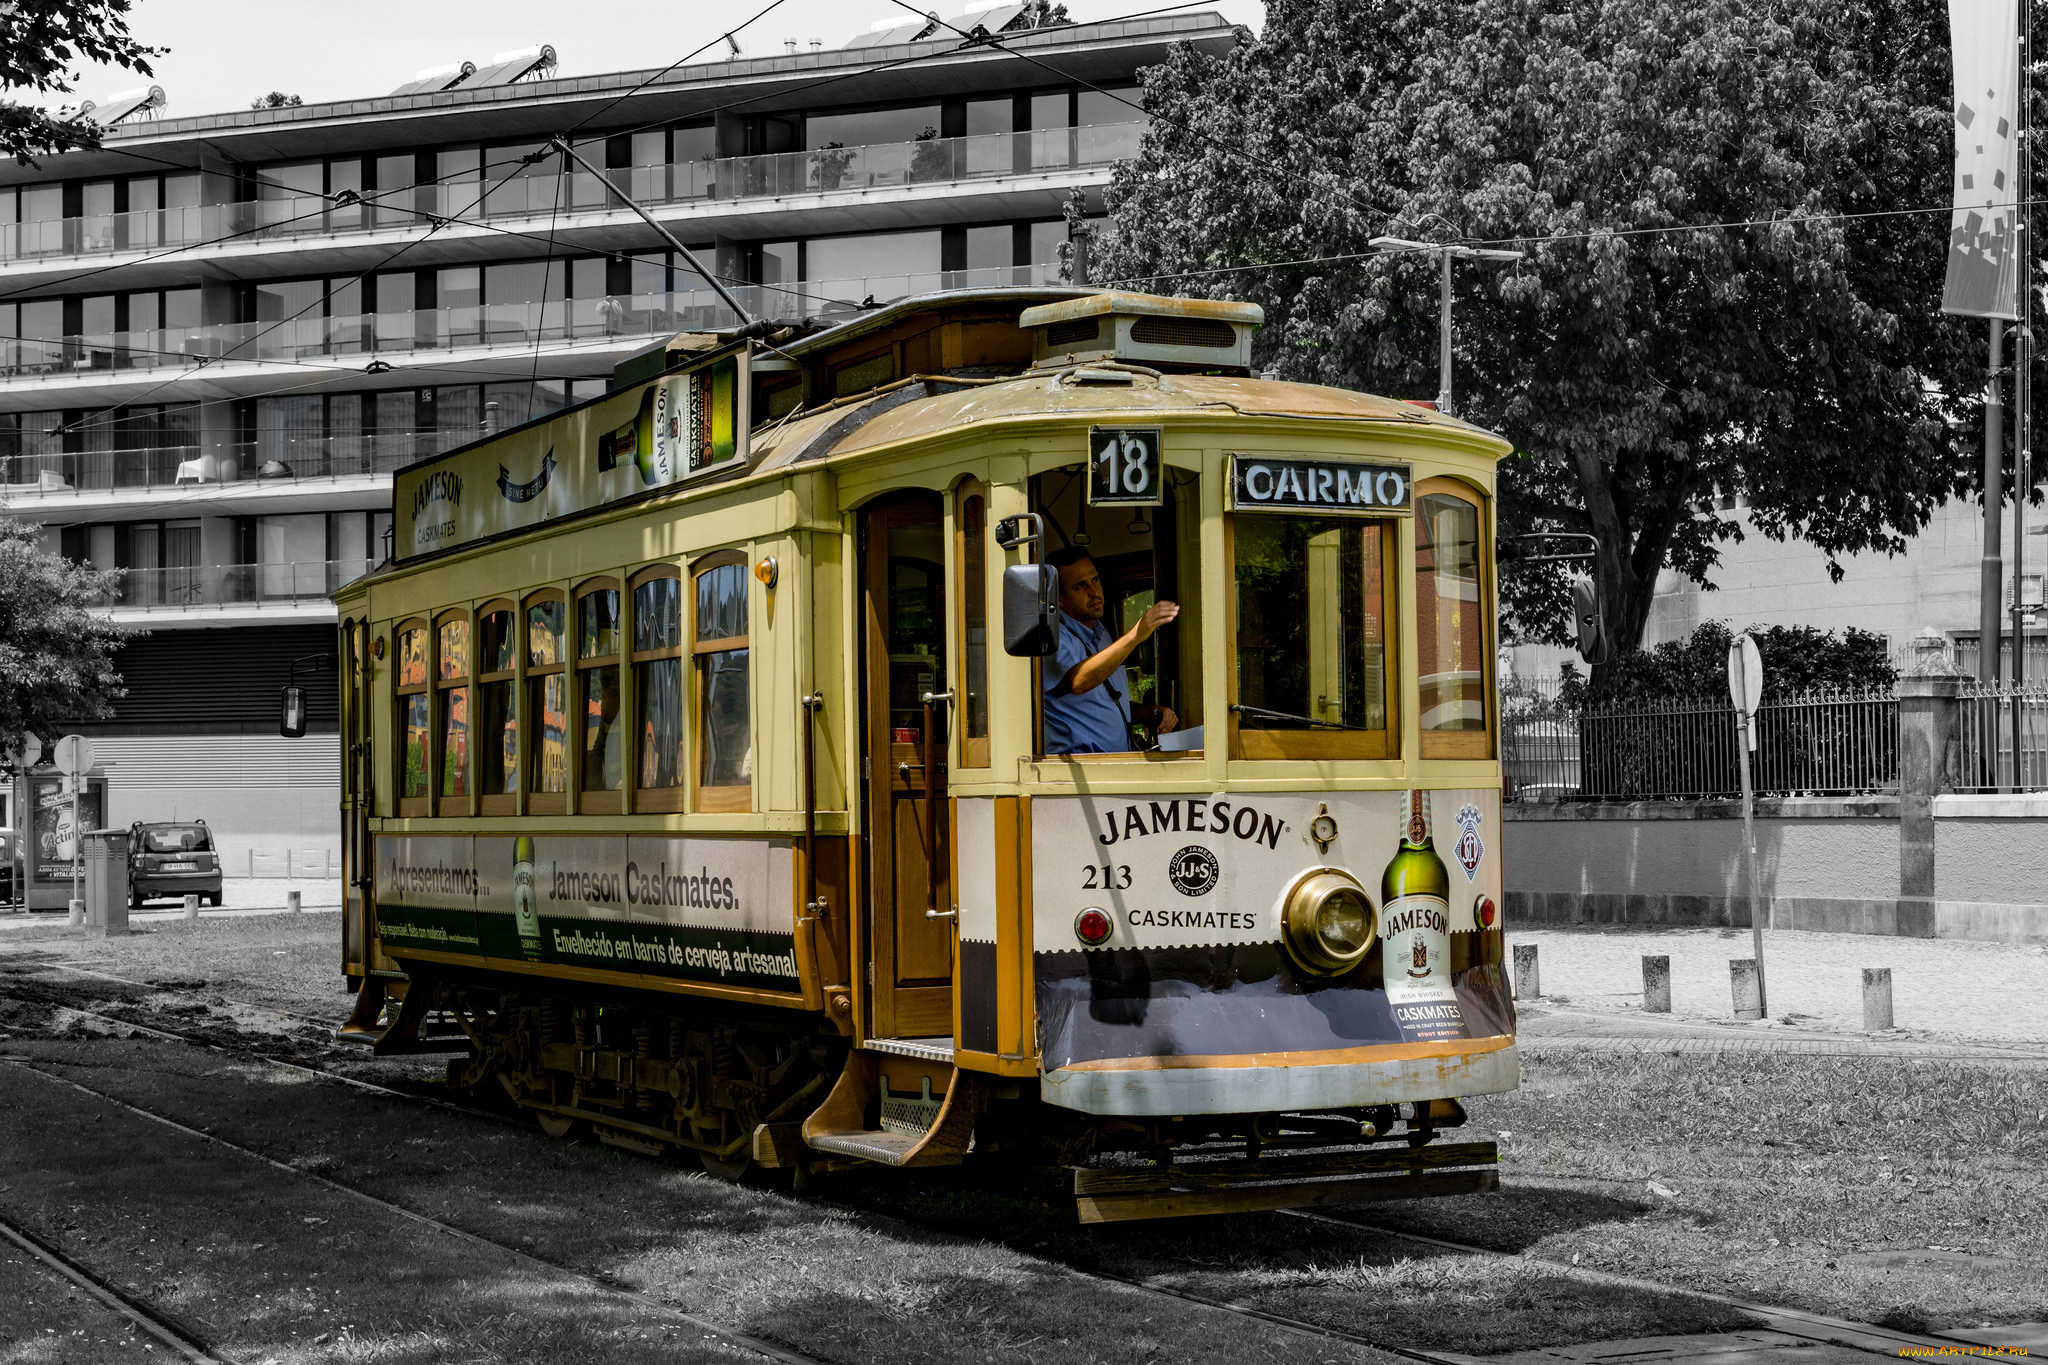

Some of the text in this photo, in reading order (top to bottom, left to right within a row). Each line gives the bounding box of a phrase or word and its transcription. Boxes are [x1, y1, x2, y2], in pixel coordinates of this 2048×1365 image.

[656, 387, 669, 475] JAMESON
[1100, 439, 1149, 494] 18
[412, 470, 463, 521] JAMESON
[508, 478, 543, 499] SINE METU
[1246, 465, 1405, 506] CARMO
[418, 520, 456, 544] CASKMATES
[1100, 800, 1286, 850] JAMESON
[1171, 847, 1217, 869] JOHN JAMESON
[1175, 862, 1209, 878] JJ&S
[390, 857, 490, 900] Apresentamos...
[550, 861, 739, 910] Jameson Caskmates.
[1081, 865, 1133, 890] 213
[1174, 881, 1189, 895] SON
[1191, 875, 1217, 895] LIMITED
[1128, 910, 1254, 929] CASKMATES
[1386, 909, 1447, 940] JAMESON
[553, 928, 799, 978] Envelhecido em barris de cerveja artesanal.
[1397, 1005, 1461, 1021] CASKMATES
